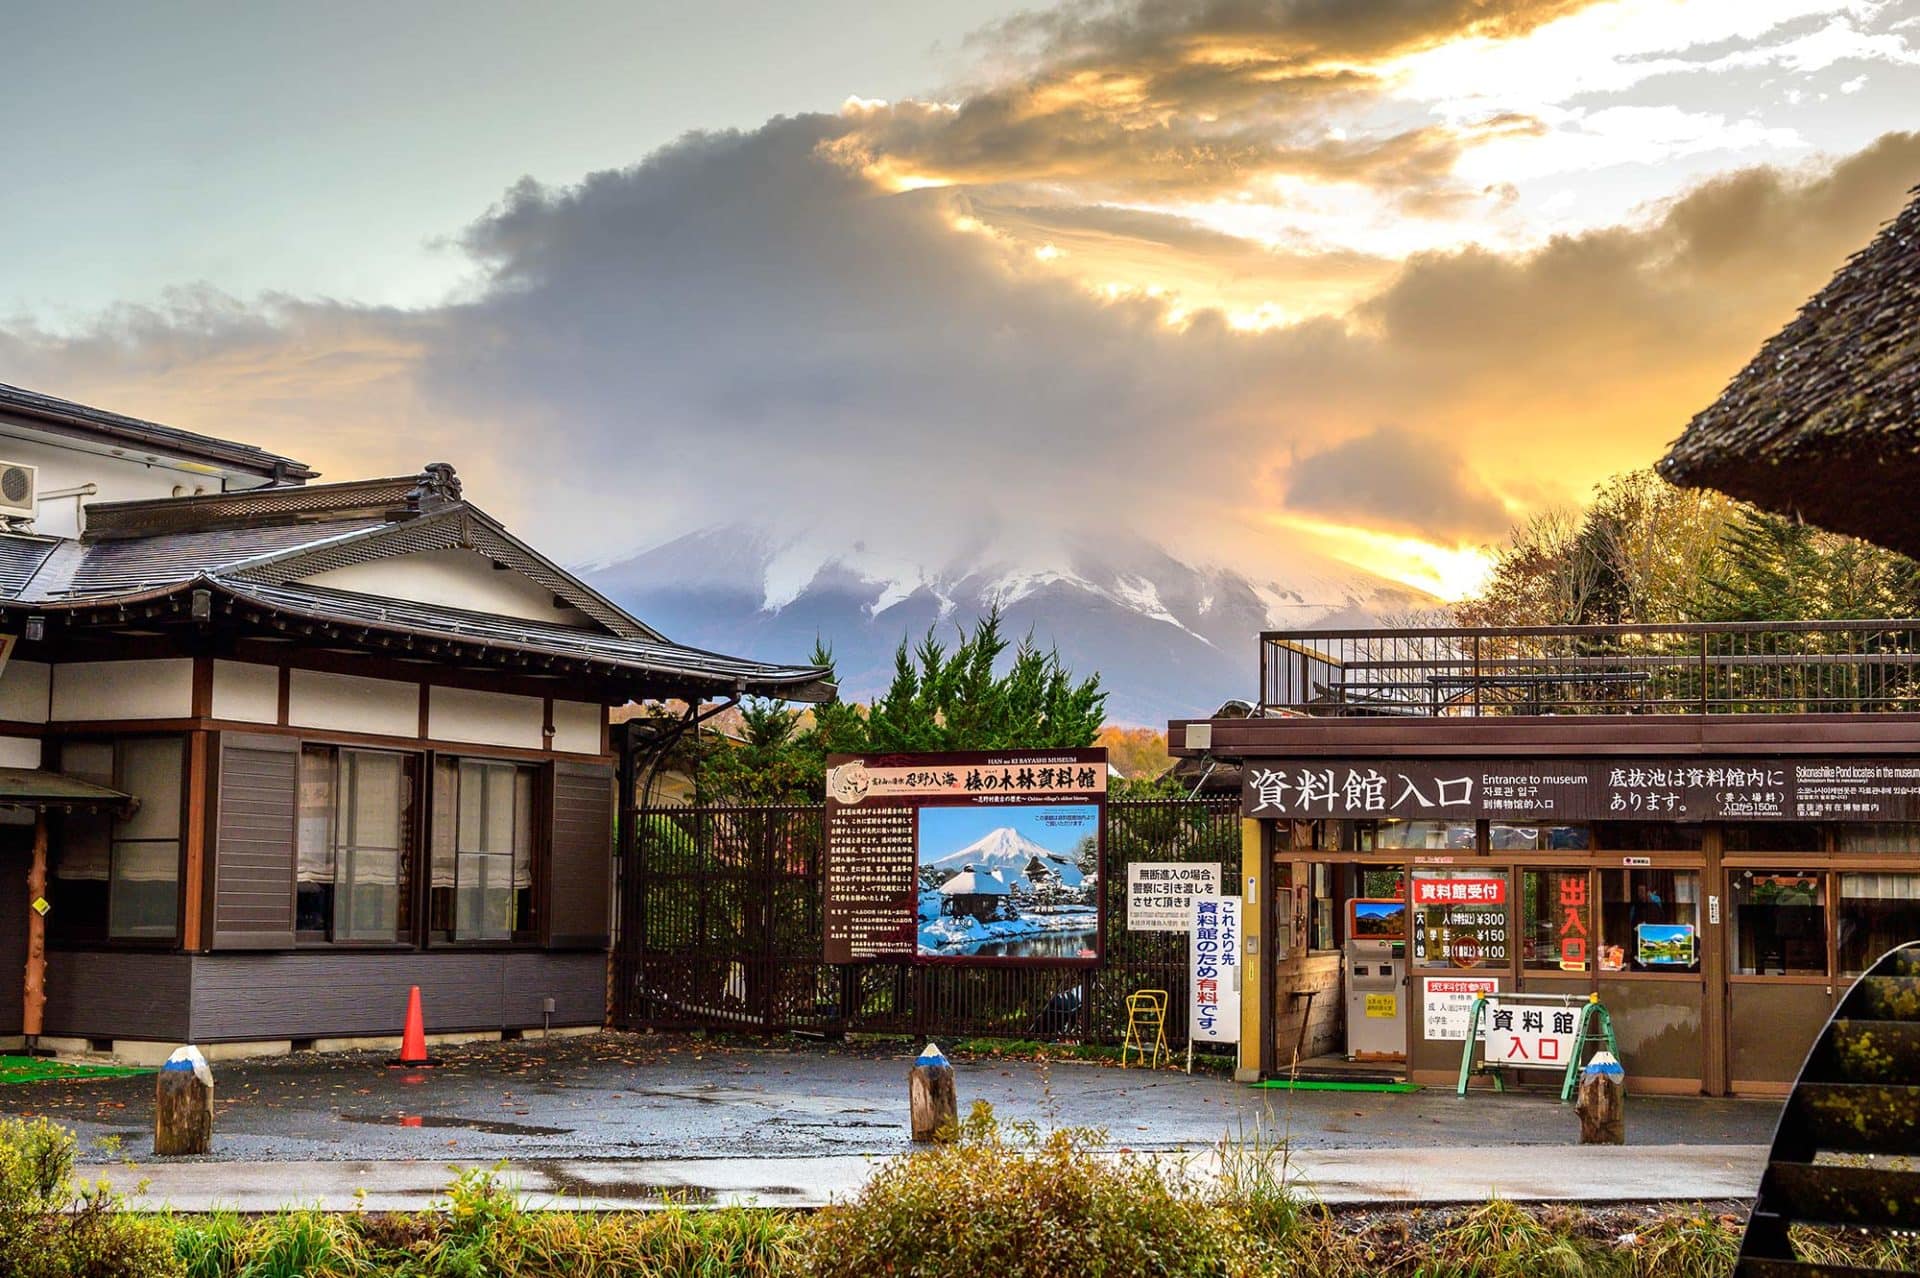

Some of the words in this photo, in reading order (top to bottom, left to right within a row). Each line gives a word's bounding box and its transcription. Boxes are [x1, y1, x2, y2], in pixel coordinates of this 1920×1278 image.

[906, 771, 958, 787] 忍野八海
[1482, 774, 1527, 784] Entrance
[1529, 776, 1541, 784] to
[1543, 776, 1588, 784] museum
[1609, 768, 1785, 788] 底抜池は資料館内に
[1835, 766, 1851, 778] Pond
[1852, 766, 1875, 778] locates
[1875, 766, 1882, 778] in
[1883, 766, 1893, 778] the
[1250, 768, 1473, 812] 資料館入口
[1482, 786, 1514, 796] 자료관
[1517, 786, 1538, 796] 입구
[1610, 791, 1687, 812] あります。
[1723, 802, 1778, 811] 入口から150m
[1139, 869, 1216, 881] 無断進入の場合、
[1132, 883, 1214, 895] 警察に引き渡しを
[1421, 884, 1498, 900] 資料館受付
[1477, 913, 1505, 926] ¥300
[1560, 878, 1587, 962] 出入口
[1221, 901, 1236, 966] これより先
[1477, 929, 1505, 942] ¥150
[1477, 945, 1505, 958] ¥100
[1197, 901, 1219, 1036] 資料館のため有料です。
[1493, 1009, 1574, 1035] 資料館
[1507, 1036, 1558, 1060] 入口
